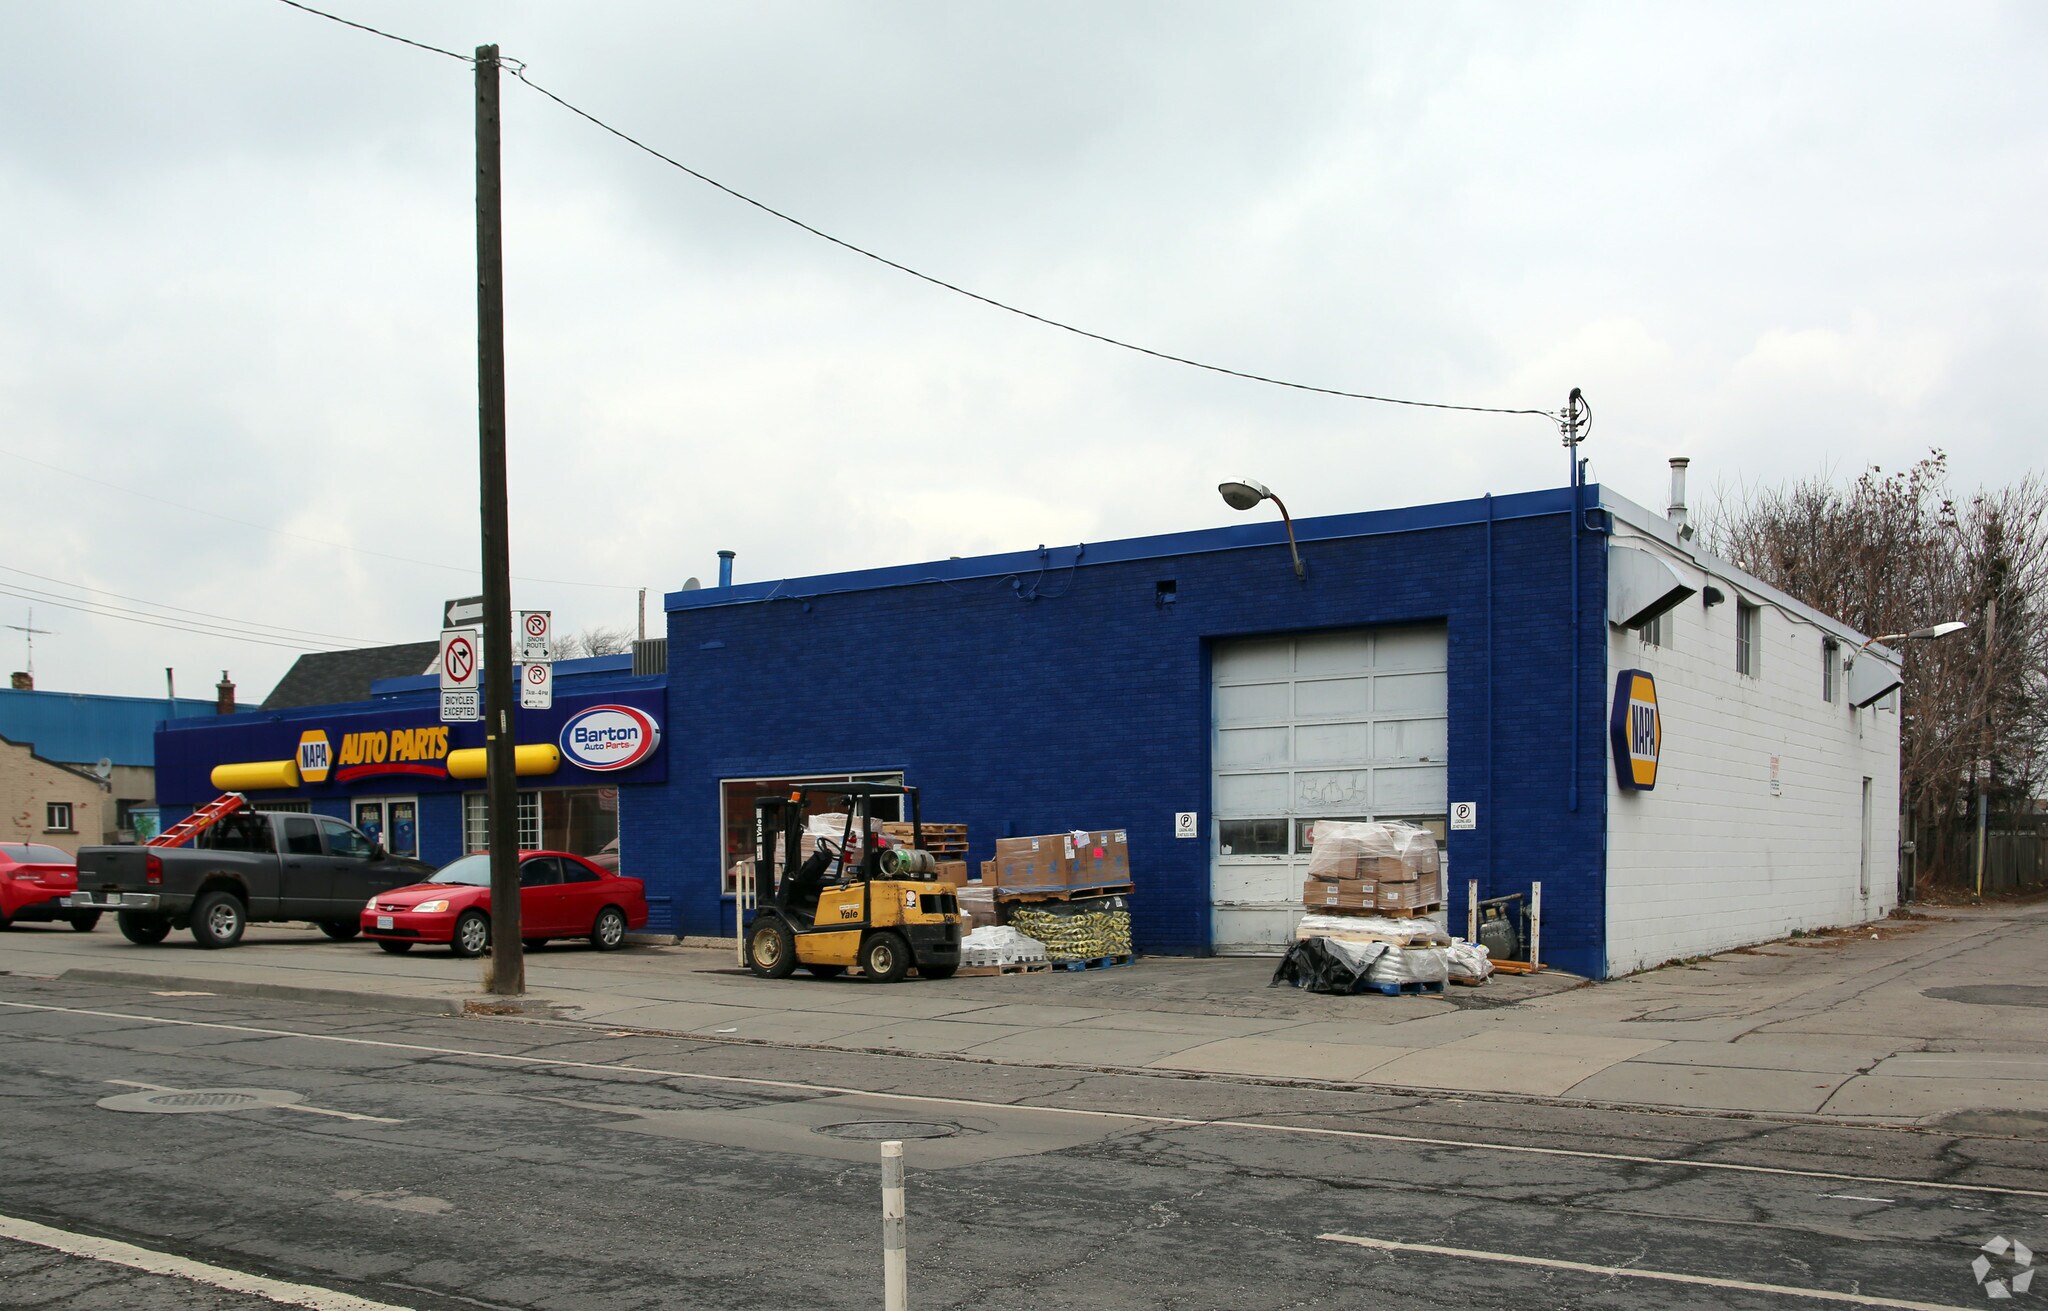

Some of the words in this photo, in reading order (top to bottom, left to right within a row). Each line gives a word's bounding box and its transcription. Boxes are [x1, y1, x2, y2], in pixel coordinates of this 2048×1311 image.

[445, 696, 474, 705] BICYCLES
[444, 707, 475, 716] EXCEPTED
[575, 727, 638, 743] Barton
[1631, 704, 1656, 756] NAPA
[338, 731, 388, 765] AUTO
[389, 725, 449, 762] PARTS
[584, 742, 604, 750] Auto
[605, 741, 630, 749] Parts
[302, 743, 327, 768] NAPA
[840, 909, 858, 919] Yale
